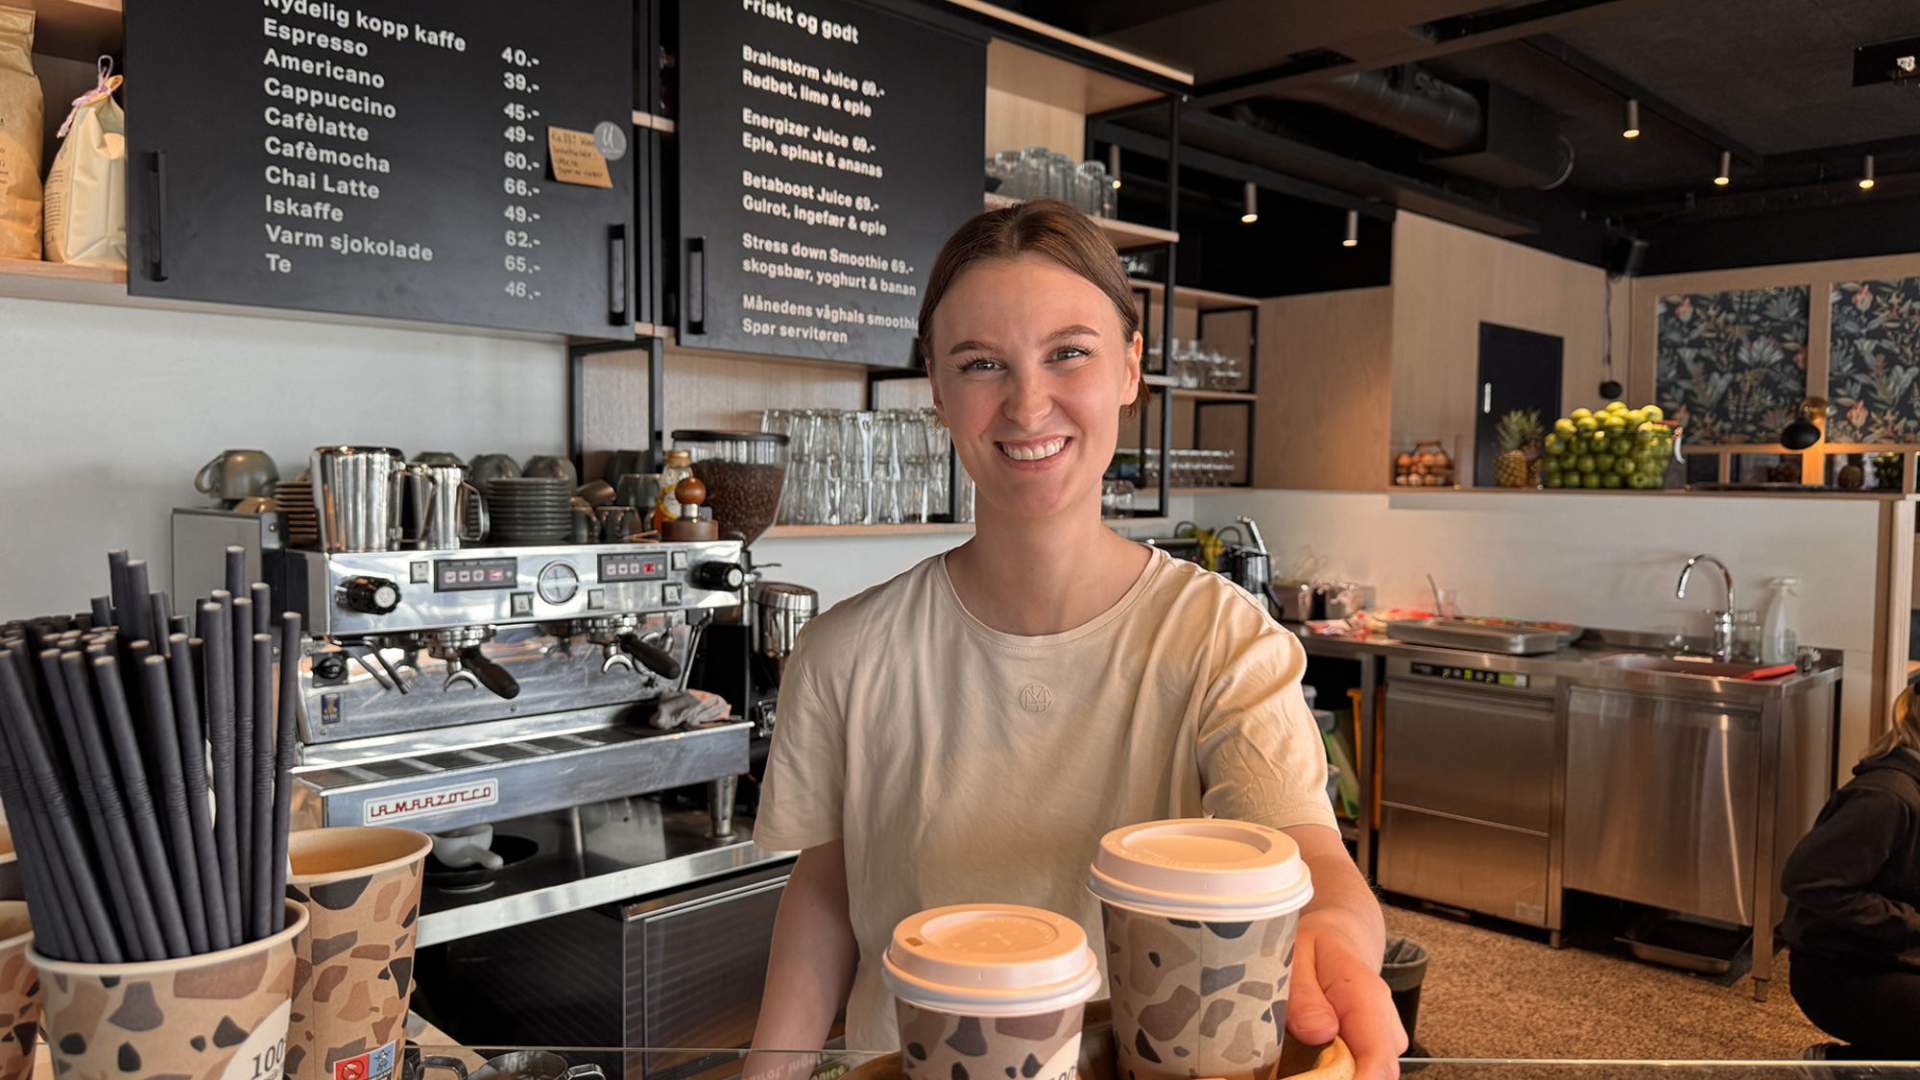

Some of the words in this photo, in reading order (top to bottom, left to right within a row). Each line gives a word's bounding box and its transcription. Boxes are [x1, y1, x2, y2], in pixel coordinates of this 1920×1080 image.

[264, 18, 368, 56] Espresso
[357, 10, 408, 40] kopp
[415, 24, 466, 51] kaffe
[797, 13, 817, 34] og
[822, 20, 858, 44] godt
[264, 48, 384, 88] Americano
[502, 47, 539, 67] 40.-
[743, 45, 819, 80] Brainstorm
[822, 69, 858, 91] Juice
[264, 77, 396, 118] Cappuccino
[504, 72, 539, 93] 39.-
[743, 69, 797, 99] Rødbet,
[800, 85, 829, 106] lime
[831, 93, 841, 109] &
[843, 99, 871, 117] eple
[265, 107, 368, 141] Cafèlatte
[504, 103, 539, 121] 45.-
[743, 108, 810, 138] Energizer
[812, 126, 848, 148] Juice
[265, 136, 389, 173] Cafèmocha
[504, 152, 540, 171] 60.-
[743, 132, 777, 155] Eple,
[781, 144, 823, 165] spinat
[826, 152, 835, 167] &
[838, 157, 882, 178] ananas
[265, 166, 315, 189] Chai
[323, 174, 379, 199] Latte
[504, 178, 540, 196] 66.-
[743, 171, 814, 200] Betaboost
[817, 187, 852, 207] Juice
[266, 195, 343, 222] Iskaffe
[504, 205, 540, 223] 49.-
[743, 195, 791, 219] Gulrot,
[794, 205, 845, 228] ingefær
[848, 216, 857, 230] &
[860, 221, 887, 236] eple
[266, 224, 323, 248] Varm
[330, 234, 432, 261] sjokolade
[505, 230, 540, 248] 62.-
[743, 233, 788, 254] Stress
[791, 242, 827, 261] down
[830, 248, 888, 271] Smoothie
[266, 253, 291, 273] Te
[505, 255, 540, 274] 65.-
[743, 258, 813, 282] skogsbær,
[817, 271, 866, 289] yoghurt
[868, 277, 878, 291] &
[880, 279, 916, 296] banan
[505, 281, 541, 300] 46.-
[743, 294, 813, 317] Månedens
[815, 304, 864, 324] våghals
[743, 318, 776, 336] Spør
[779, 325, 847, 344] servitøren
[371, 804, 388, 817] LA
